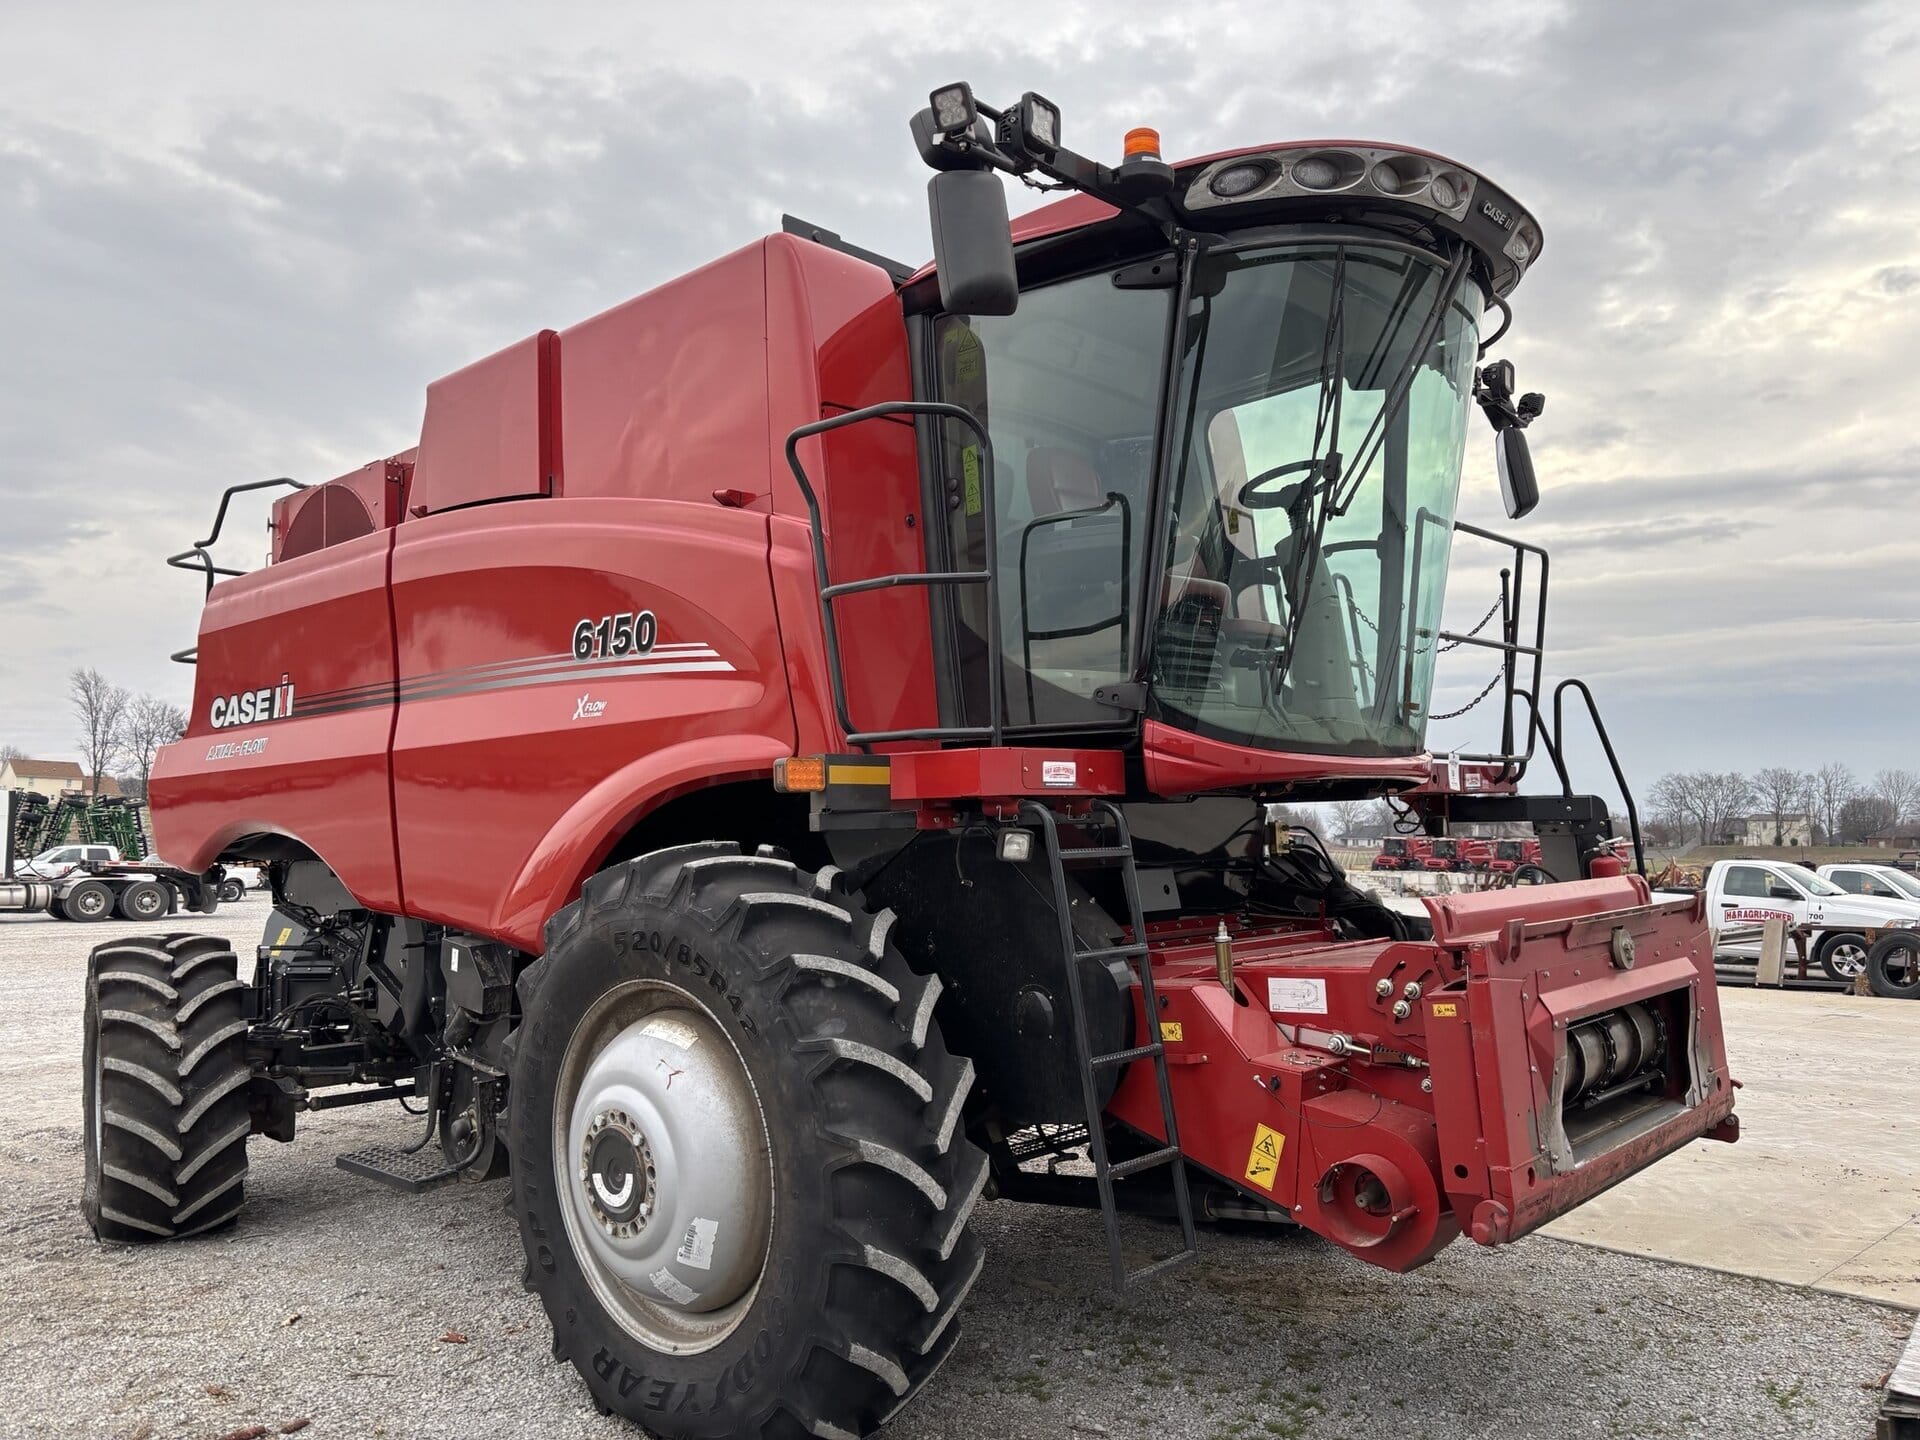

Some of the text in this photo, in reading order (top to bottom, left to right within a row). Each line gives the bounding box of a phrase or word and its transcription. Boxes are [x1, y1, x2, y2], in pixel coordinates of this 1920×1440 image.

[1483, 202, 1507, 225] CASE
[572, 610, 657, 661] 6150
[210, 689, 271, 729] CASE
[1808, 913, 1824, 921] 700
[613, 930, 760, 1042] 520/85R42
